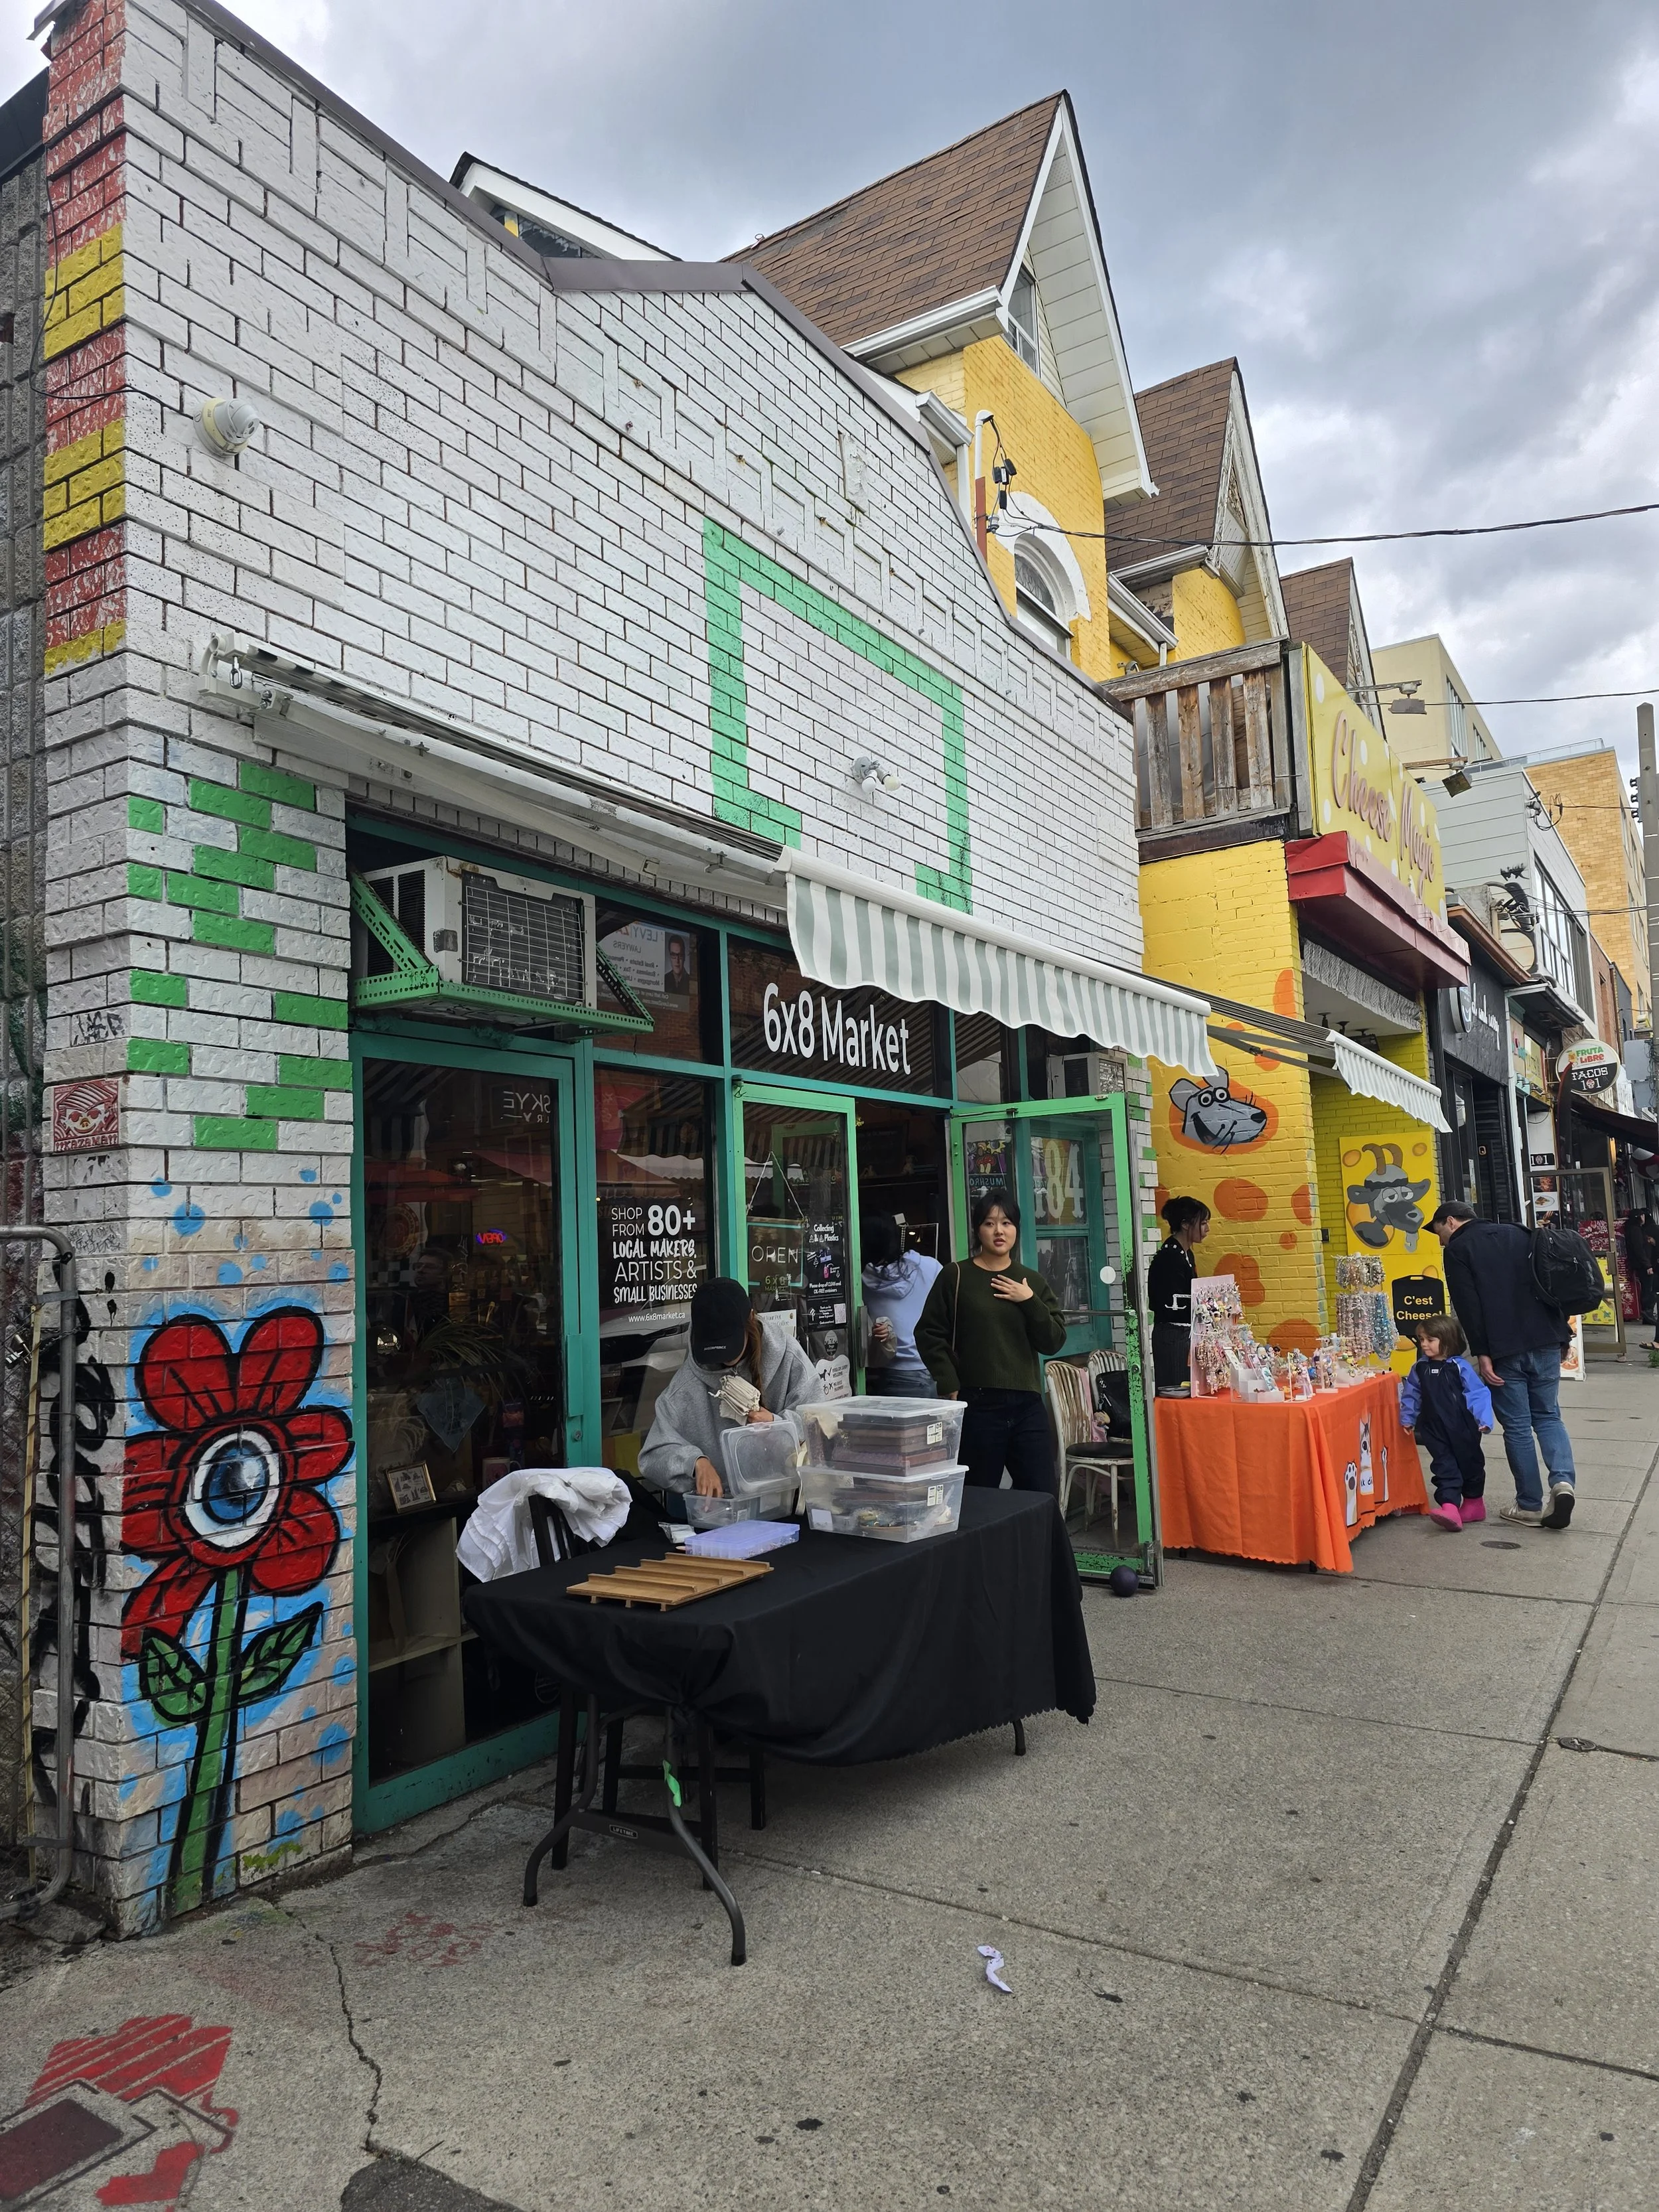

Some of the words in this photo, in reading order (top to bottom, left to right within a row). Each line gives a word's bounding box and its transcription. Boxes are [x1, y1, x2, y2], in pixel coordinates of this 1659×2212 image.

[1333, 709, 1393, 842] Cheese
[1400, 781, 1435, 900] Magic
[764, 982, 816, 1059] 6x8
[821, 995, 911, 1075] Market
[1576, 1046, 1604, 1057] FRUTA
[1571, 1067, 1609, 1080] TACOS
[611, 1207, 643, 1220] SHOP
[648, 1205, 696, 1236] 80+
[612, 1223, 644, 1236] FROM
[613, 1238, 647, 1259] LOCAL
[650, 1238, 697, 1259] MAKERS,
[751, 1245, 799, 1264] OPEN
[614, 1260, 682, 1282] ARTISTS
[686, 1260, 697, 1279] &
[613, 1286, 647, 1303] SMALL
[649, 1283, 697, 1301] BUSINESSES
[1404, 1295, 1433, 1305] C'est
[628, 1311, 685, 1323] www.6x8market.ca
